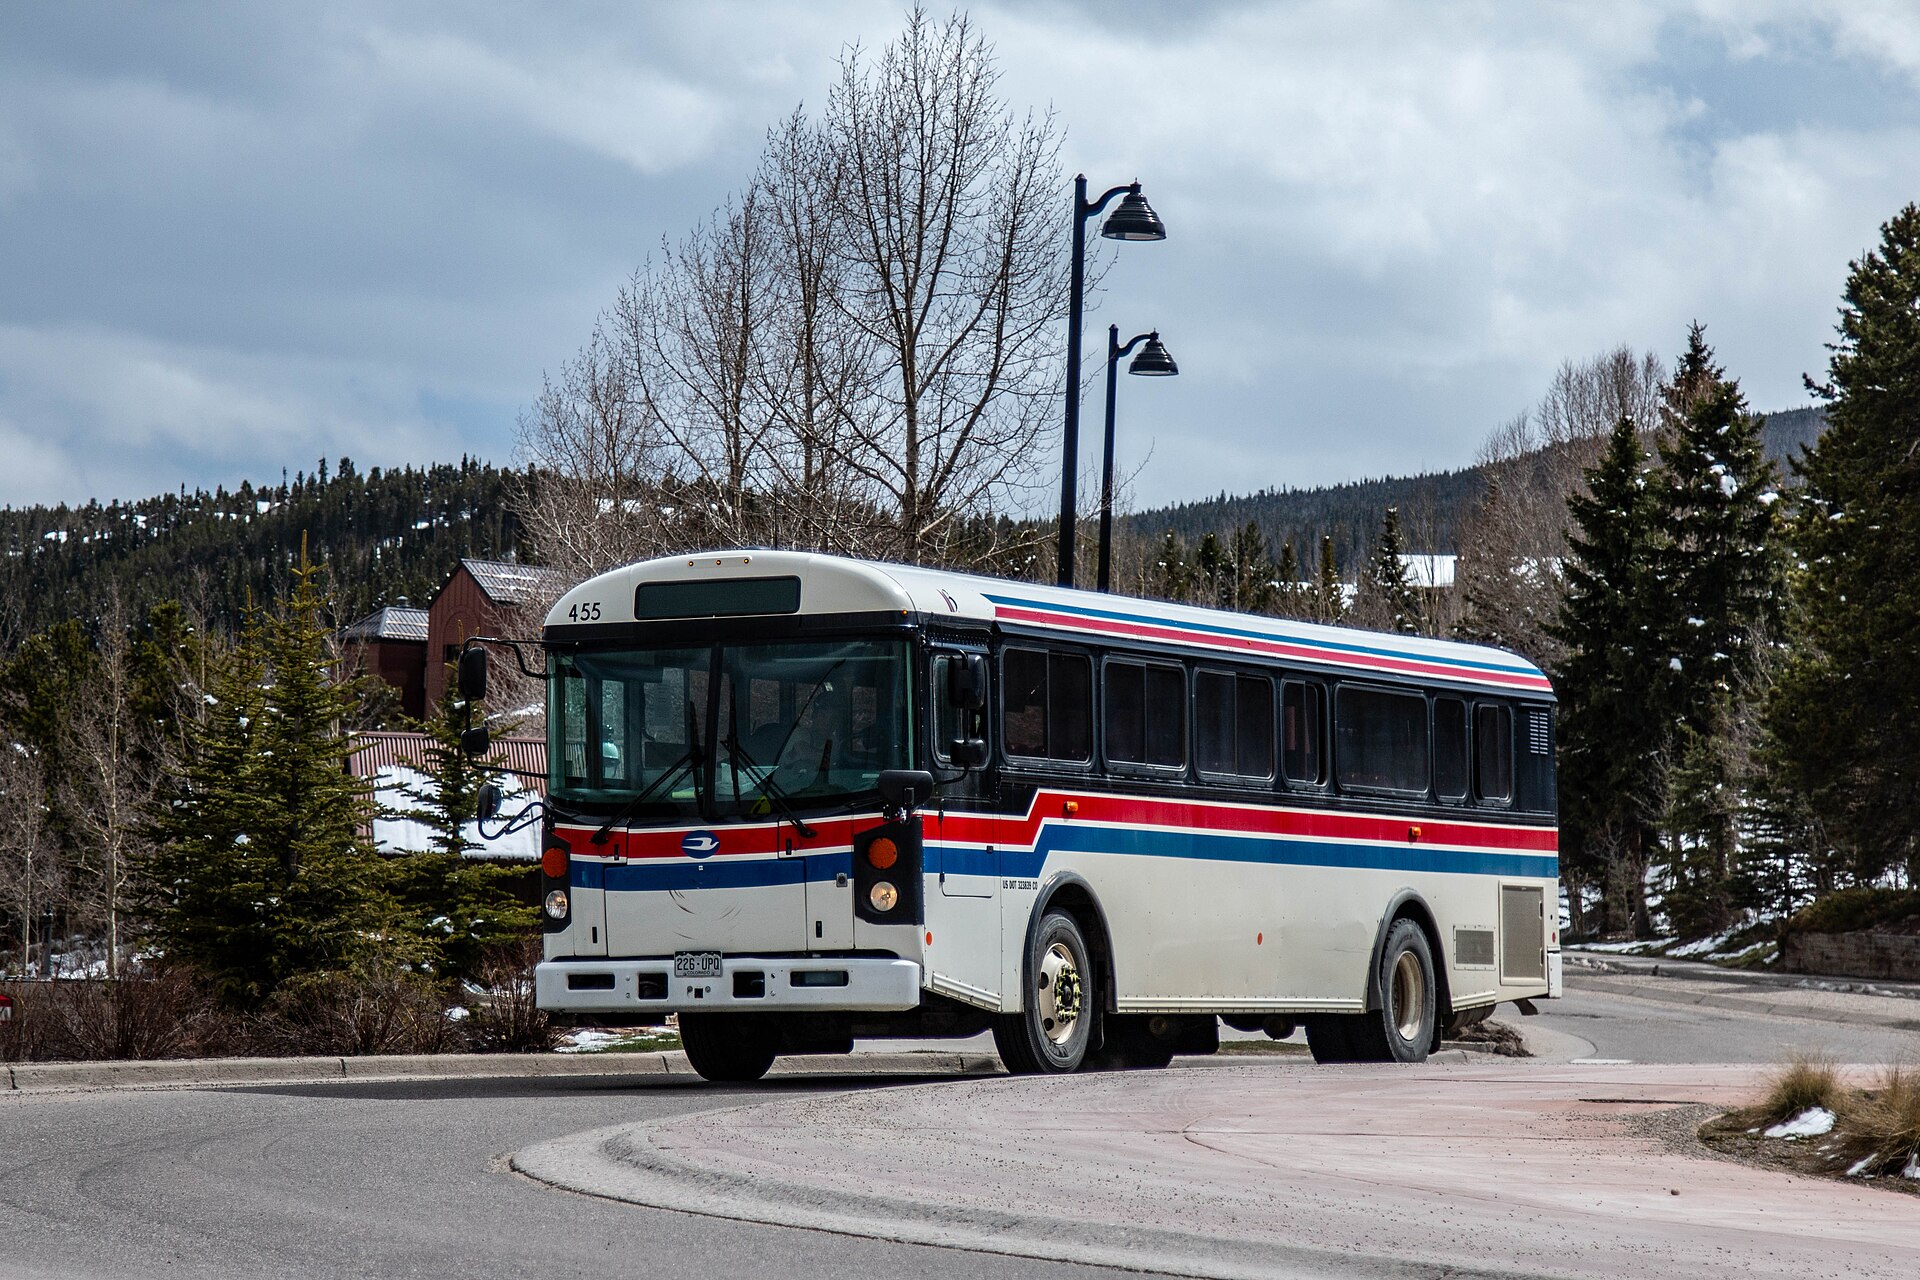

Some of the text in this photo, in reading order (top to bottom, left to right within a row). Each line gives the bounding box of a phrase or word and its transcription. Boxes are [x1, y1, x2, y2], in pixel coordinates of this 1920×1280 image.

[568, 602, 601, 622] 455
[1003, 880, 1008, 890] US
[1009, 880, 1017, 890] DOT
